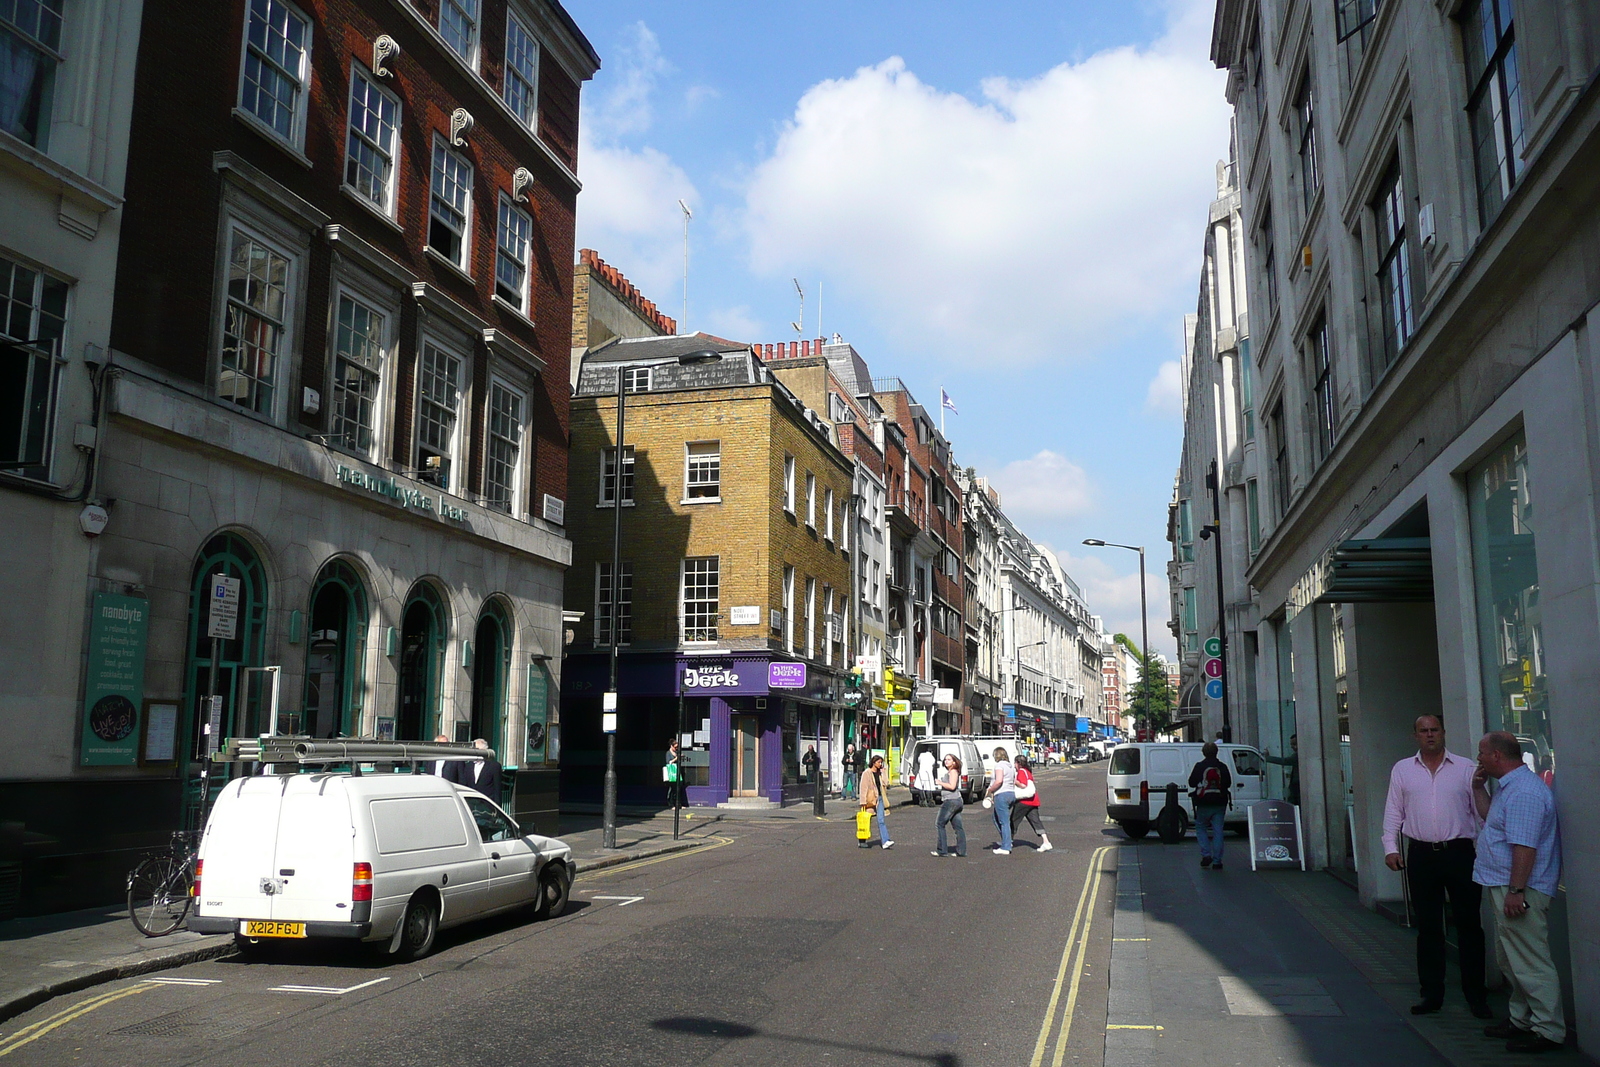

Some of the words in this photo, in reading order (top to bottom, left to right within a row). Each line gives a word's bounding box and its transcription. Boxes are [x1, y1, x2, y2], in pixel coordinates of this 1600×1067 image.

[336, 464, 432, 511] nanobyte
[438, 494, 469, 522] bar
[218, 587, 223, 596] P
[102, 603, 142, 625] nanobyte
[100, 635, 110, 643] and
[110, 635, 129, 646] friendly
[102, 648, 121, 658] serving
[122, 648, 135, 657] fresh
[118, 660, 132, 669] great
[699, 664, 723, 674] mr
[124, 671, 134, 680] and
[772, 665, 802, 677] Jerk
[684, 667, 739, 688] Jerk
[92, 714, 115, 733] LIVE
[100, 707, 132, 740] RUGBY
[116, 724, 133, 740] HERE
[249, 922, 274, 935] X212
[276, 923, 300, 935] FGJ
